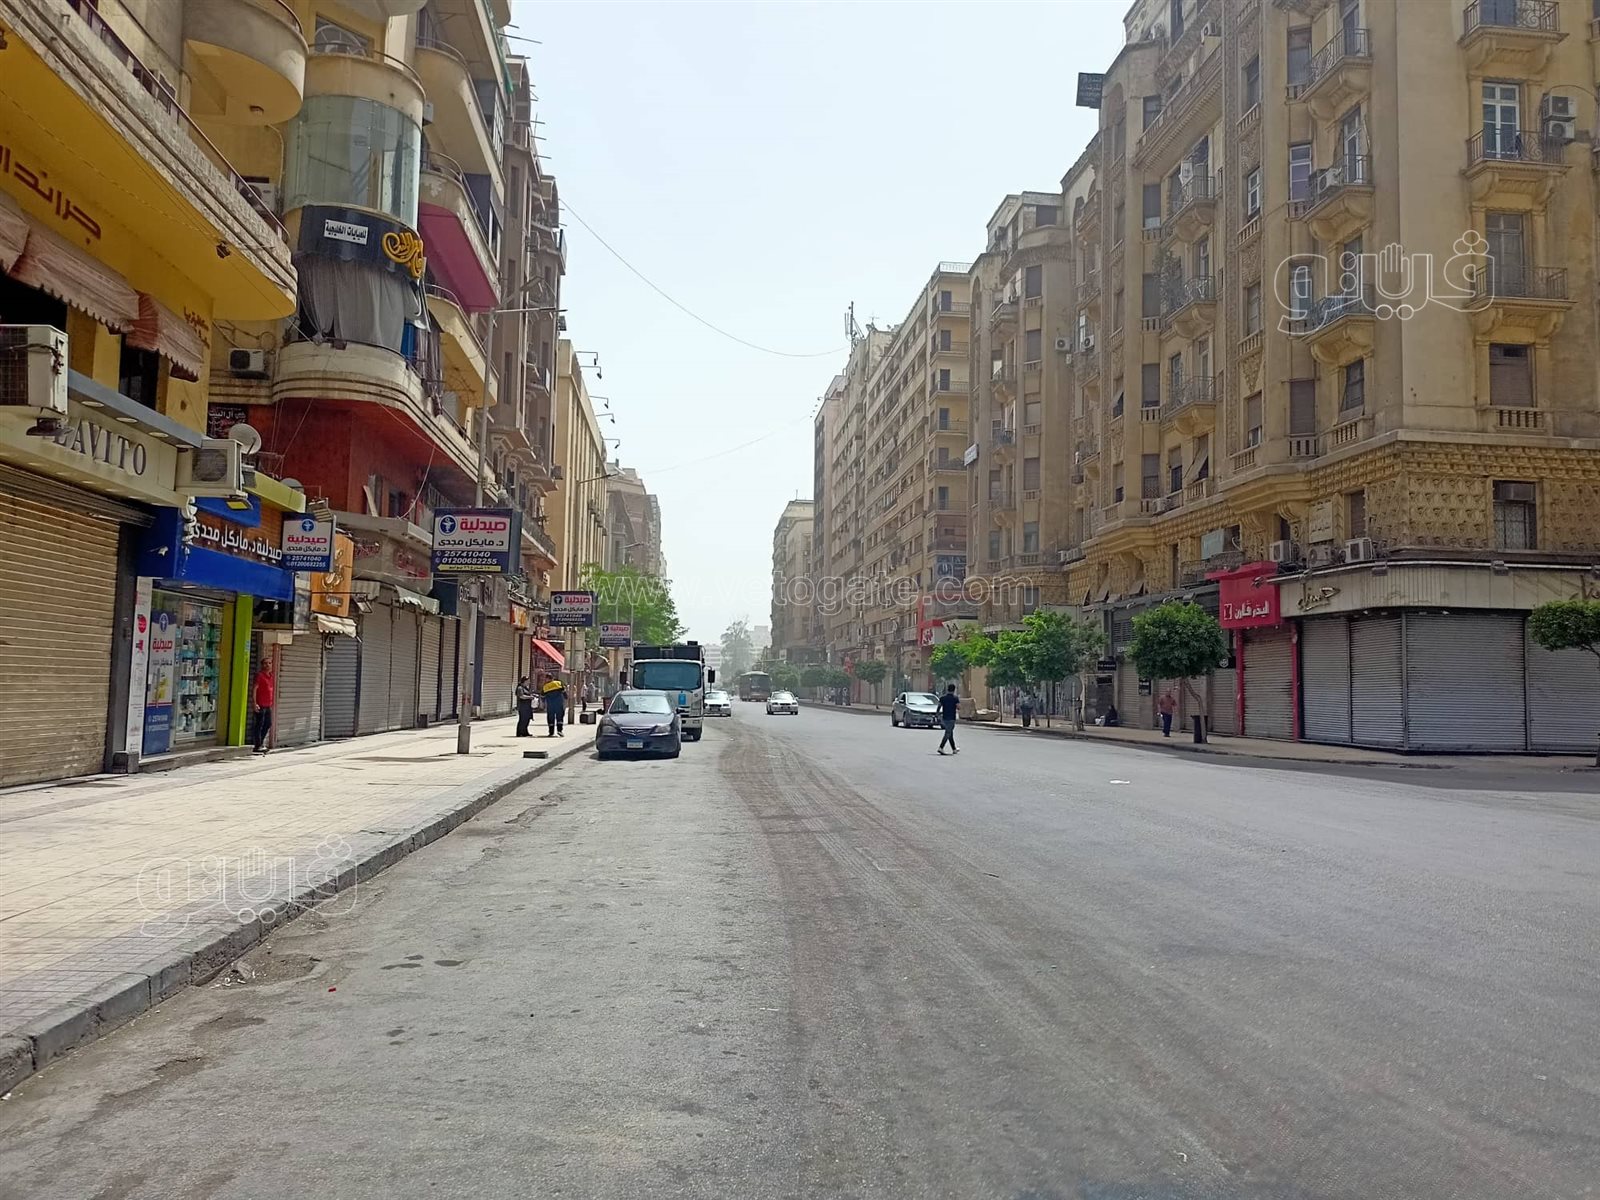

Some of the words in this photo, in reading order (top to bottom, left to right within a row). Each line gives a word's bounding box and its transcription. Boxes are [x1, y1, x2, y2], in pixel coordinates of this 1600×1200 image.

[460, 518, 507, 533] صيدلية
[221, 524, 248, 553] مايكل
[287, 535, 328, 546] صيدلية
[464, 538, 495, 547] مايكل
[256, 536, 283, 564] صيدلية
[444, 550, 491, 558] 25741040
[152, 637, 174, 653] صيدلية
